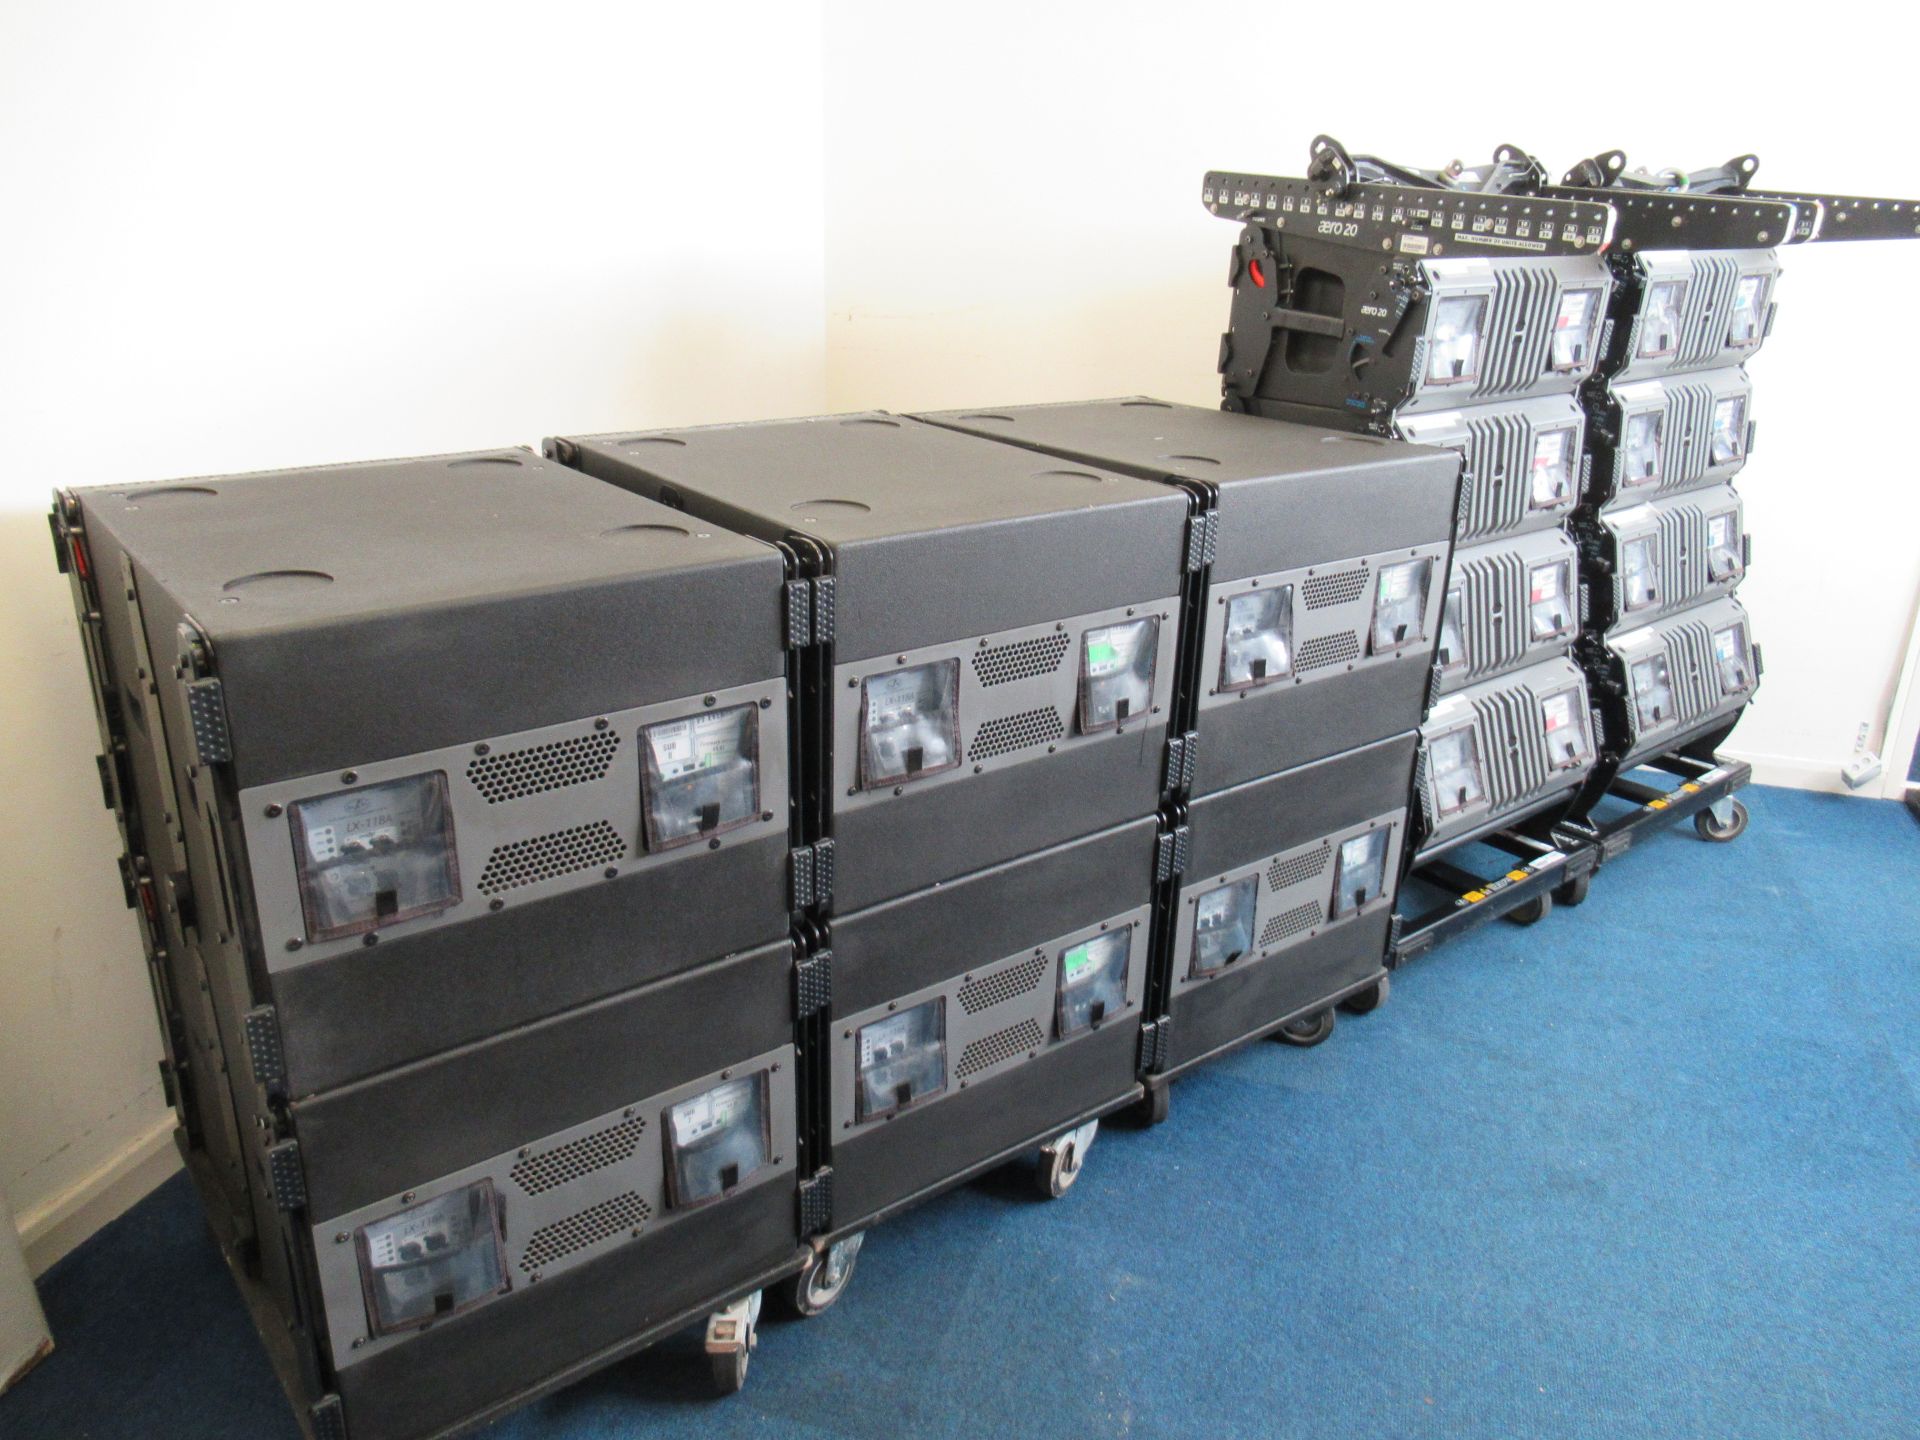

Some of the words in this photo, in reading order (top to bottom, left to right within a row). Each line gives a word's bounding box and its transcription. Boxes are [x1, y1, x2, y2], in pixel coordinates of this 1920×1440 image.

[1318, 220, 1342, 235] aero
[1343, 223, 1358, 237] 20
[1518, 240, 1544, 249] ALLOWED
[1361, 305, 1377, 316] aero
[1377, 308, 1388, 317] 20
